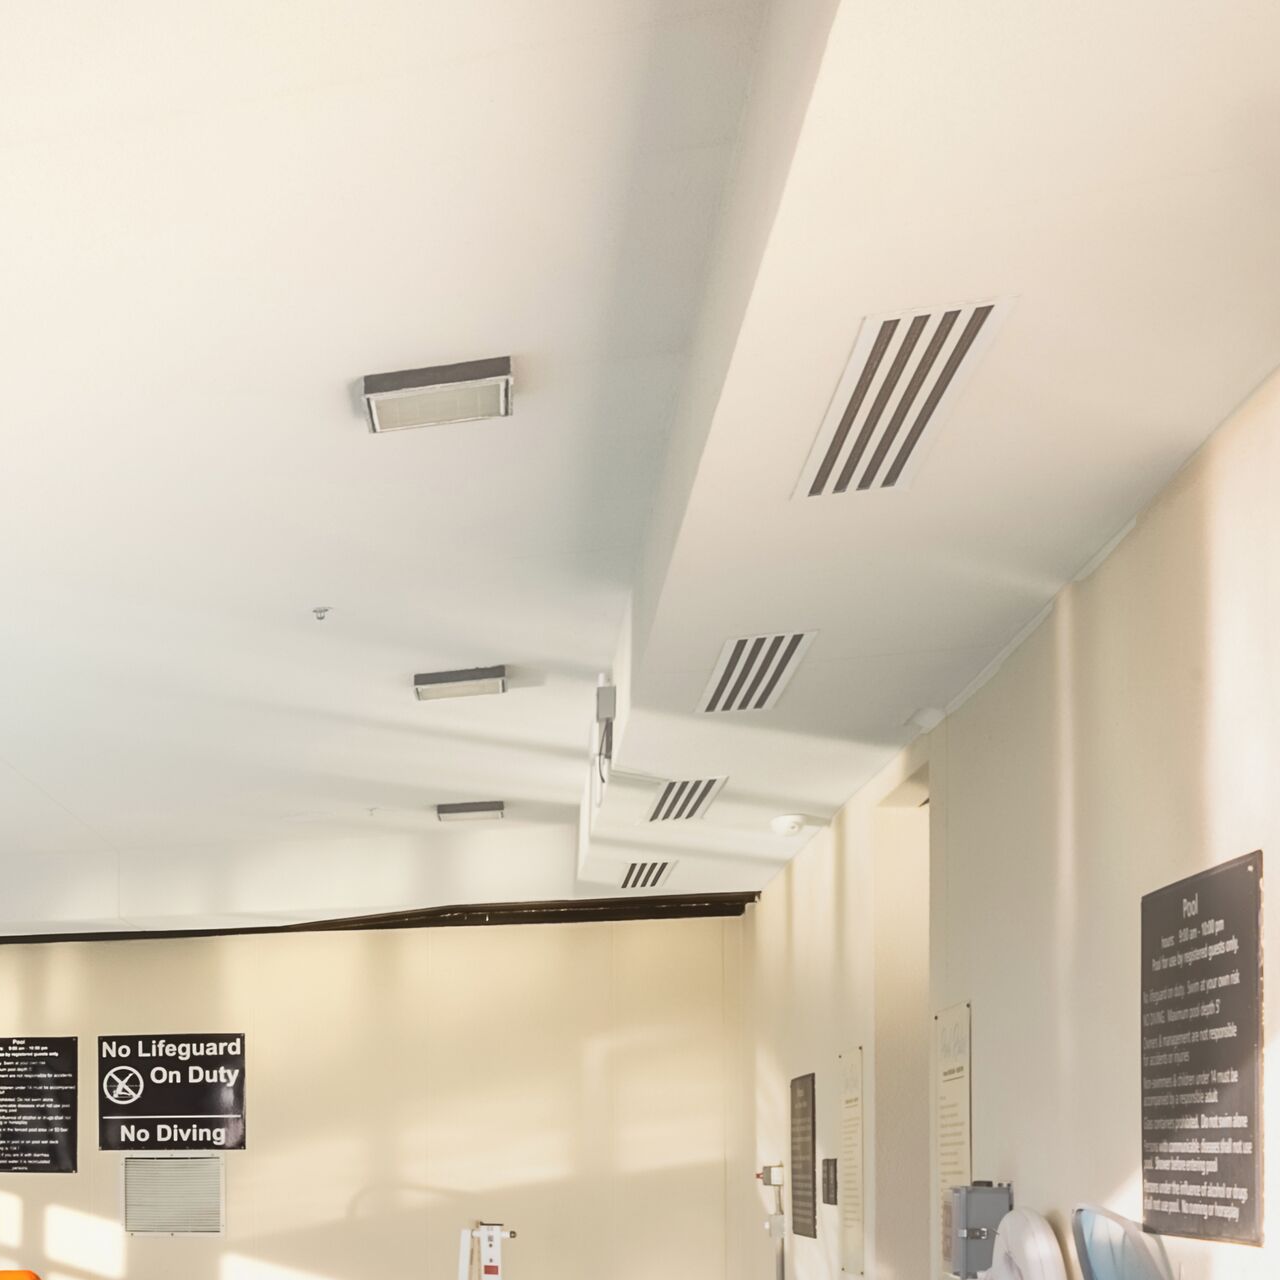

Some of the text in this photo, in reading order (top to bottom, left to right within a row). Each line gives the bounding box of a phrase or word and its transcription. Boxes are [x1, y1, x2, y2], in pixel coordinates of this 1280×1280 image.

[1182, 893, 1198, 919] Pool
[1189, 926, 1197, 941] am
[1201, 917, 1214, 937] 10:00
[1214, 917, 1224, 936] pm
[1151, 956, 1160, 972] Pool
[1168, 955, 1176, 967] use
[1183, 943, 1207, 967] registered
[1208, 940, 1224, 961] guests
[1186, 977, 1199, 995] Swim
[1206, 976, 1217, 994] your
[1218, 973, 1229, 987] own
[1230, 967, 1240, 985] risk
[1189, 1002, 1199, 1021] pool
[1200, 999, 1215, 1019] depth
[1199, 1026, 1208, 1041] not
[1208, 1020, 1237, 1043] responsible
[102, 1038, 241, 1061] No Lifeguard
[150, 1066, 240, 1087] On Duty
[1217, 1068, 1229, 1083] must
[1230, 1065, 1238, 1082] be
[1204, 1086, 1218, 1103] adult
[1218, 1111, 1232, 1127] swim
[120, 1124, 226, 1146] No Diving
[1232, 1139, 1242, 1153] not
[1242, 1141, 1252, 1153] use
